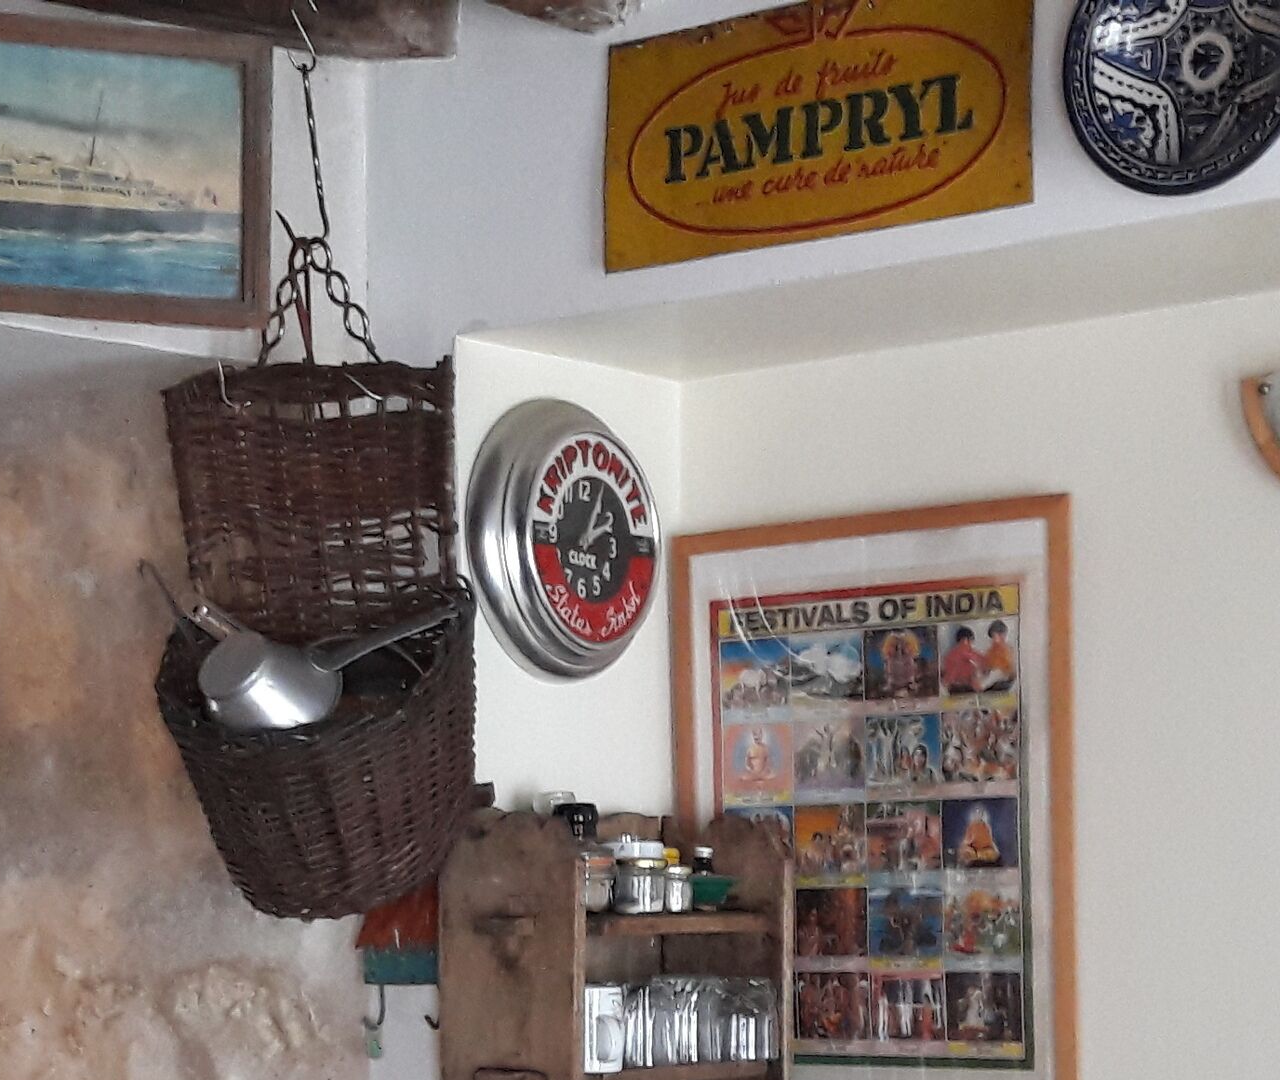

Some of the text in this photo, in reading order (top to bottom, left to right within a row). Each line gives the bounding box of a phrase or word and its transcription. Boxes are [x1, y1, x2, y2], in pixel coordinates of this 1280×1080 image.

[663, 73, 975, 185] PAMPRYL
[608, 536, 617, 559] 3
[602, 561, 611, 582] 4
[577, 577, 587, 599] 6
[591, 574, 601, 597] 5
[730, 589, 1004, 632] FESTIVALS OF INDIA
